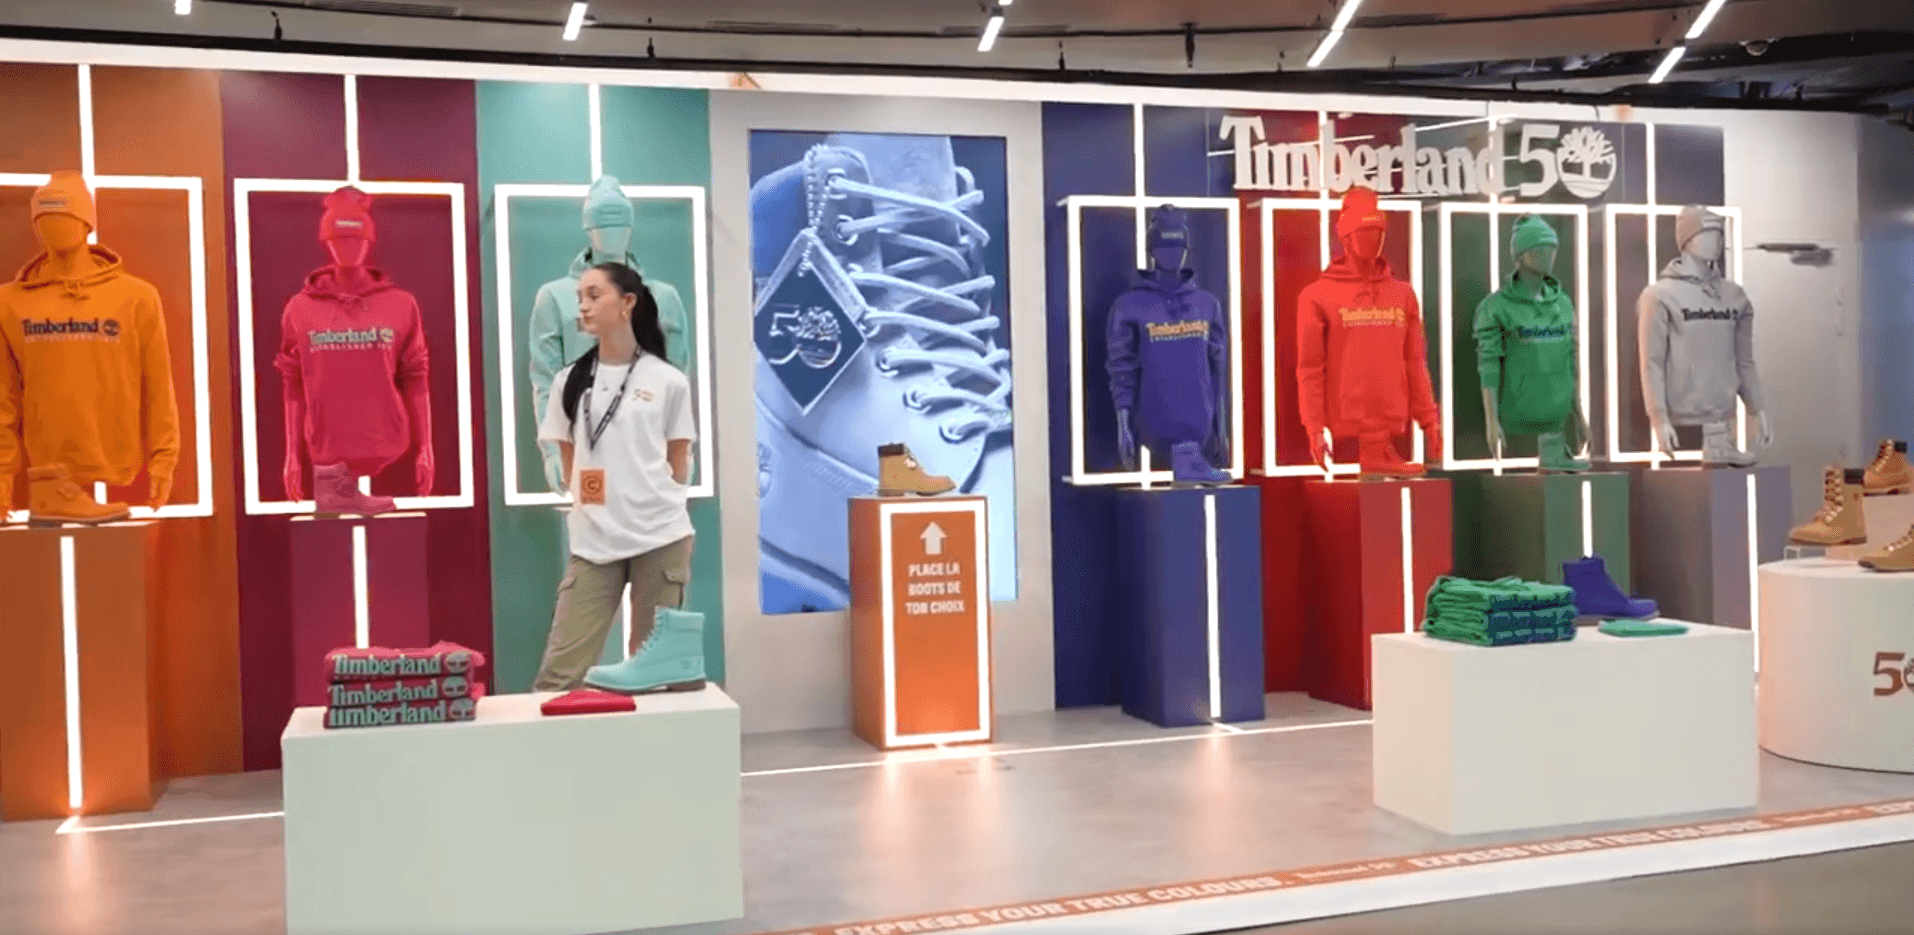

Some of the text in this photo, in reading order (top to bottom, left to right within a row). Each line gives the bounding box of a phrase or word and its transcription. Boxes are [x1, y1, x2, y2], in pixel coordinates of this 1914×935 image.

[1219, 115, 1504, 196] Timberland
[1682, 308, 1731, 321] Timberland
[21, 318, 99, 336] Timberland
[308, 327, 377, 344] Timberland
[908, 562, 960, 577] PLACE LA
[908, 581, 961, 596] BOOTS DE
[930, 600, 965, 614] CHOIX
[332, 652, 442, 675] Timberland
[328, 679, 438, 706] Timberland
[1407, 846, 1530, 868] EXPRESS
[836, 913, 980, 935] EXPRESS
[978, 900, 1070, 922] YOUR
[1068, 892, 1149, 912] TRUE
